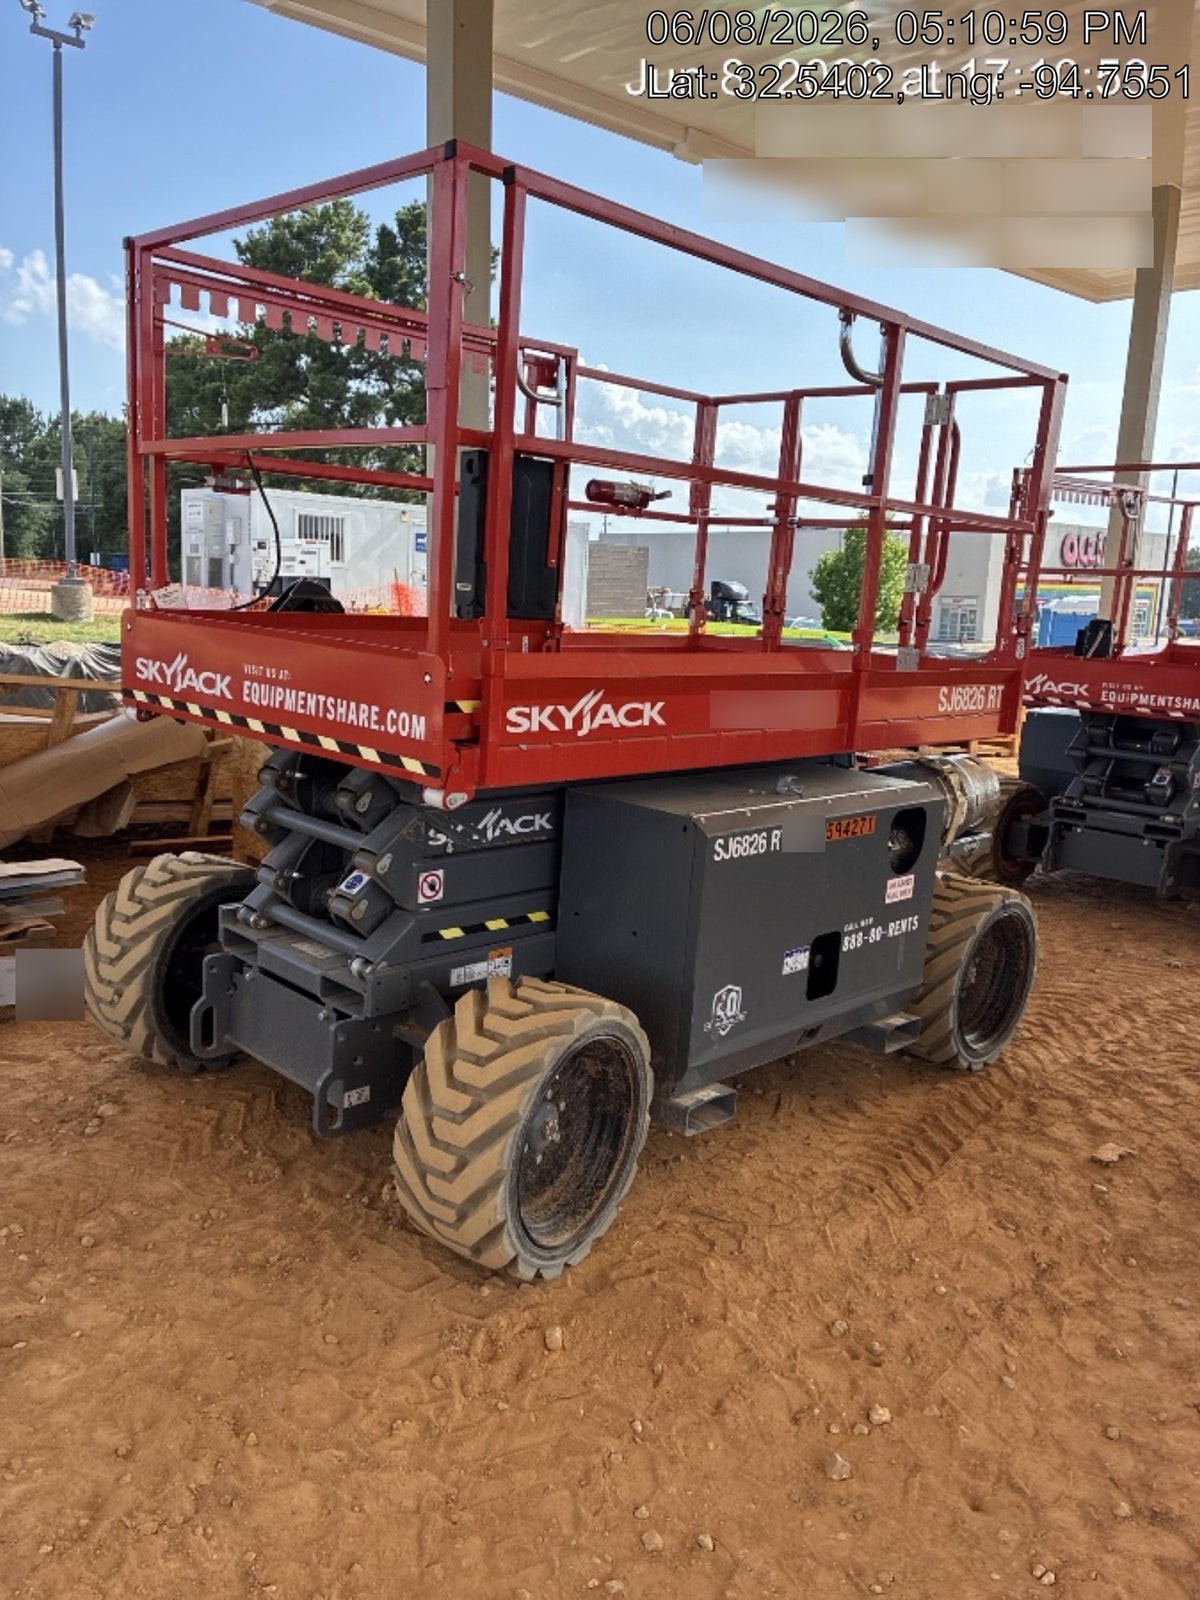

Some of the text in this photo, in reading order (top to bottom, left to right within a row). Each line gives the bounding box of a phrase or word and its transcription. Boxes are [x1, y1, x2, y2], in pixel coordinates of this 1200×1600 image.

[136, 652, 233, 699] SKYJACK
[1024, 673, 1089, 696] YJACK
[243, 680, 426, 741] EQUIPMENTSHARE.COM
[506, 690, 667, 736] SKYJACK
[939, 684, 1005, 712] SJ6826 RT
[826, 816, 873, 840] 594271
[714, 830, 782, 861] SJ6826 R
